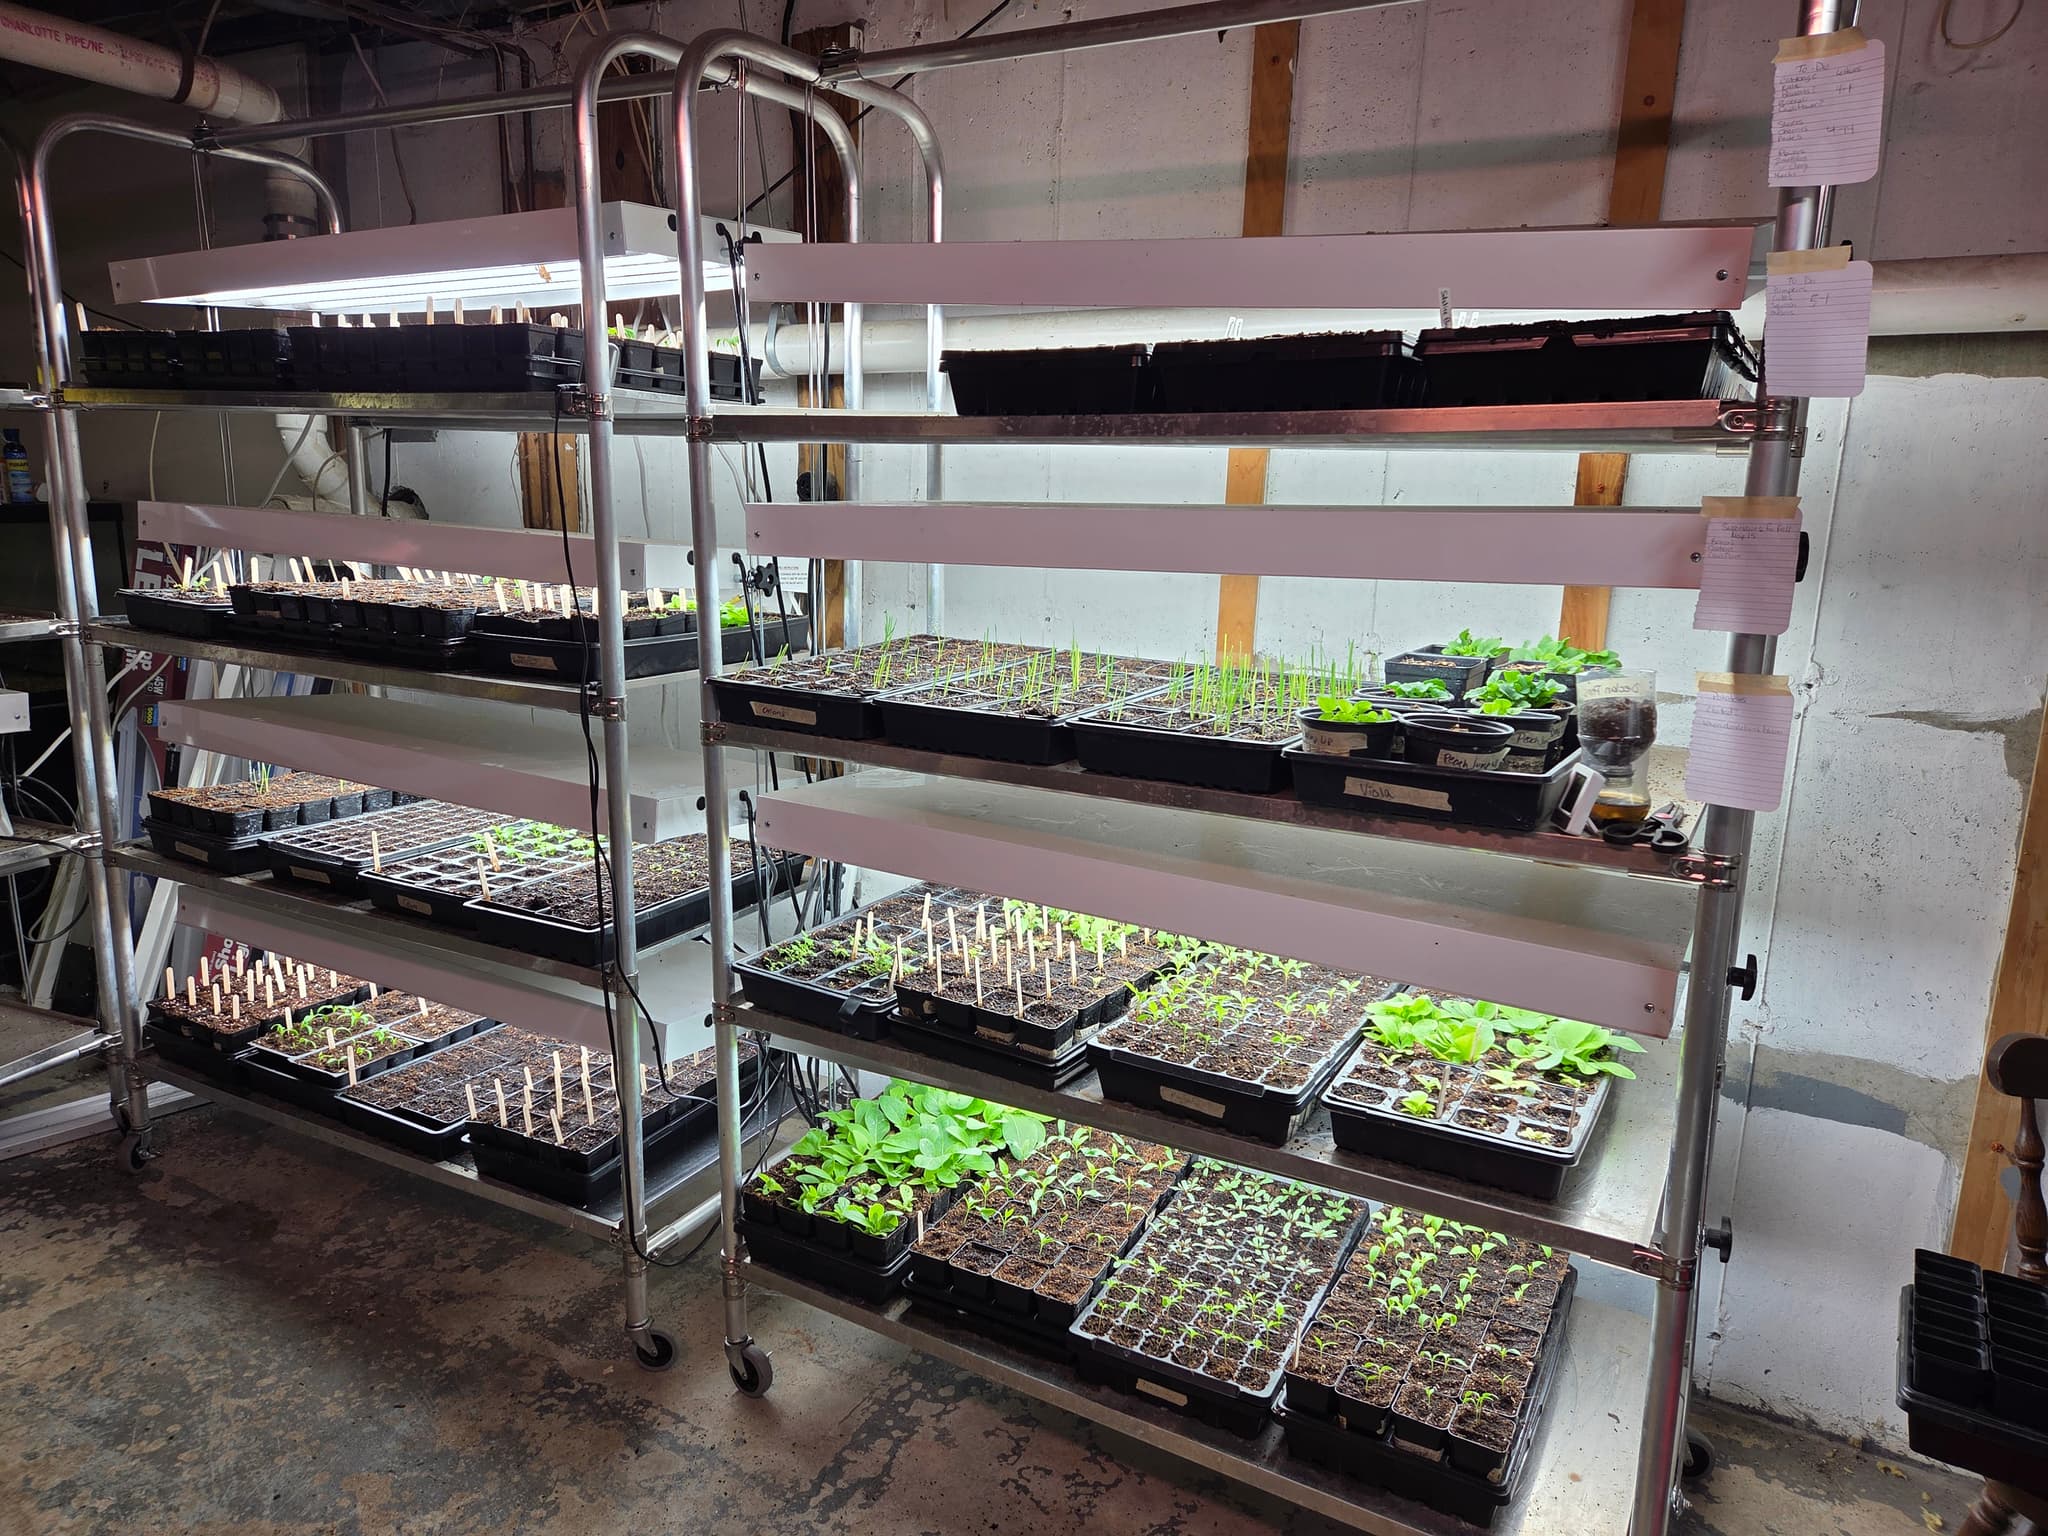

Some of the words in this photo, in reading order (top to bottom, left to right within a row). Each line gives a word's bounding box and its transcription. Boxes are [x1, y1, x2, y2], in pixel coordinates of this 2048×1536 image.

[0, 16, 61, 41] CHARLOTTE
[153, 675, 165, 695] 45W
[1443, 753, 1469, 768] Peach
[1360, 783, 1394, 799] Viola
